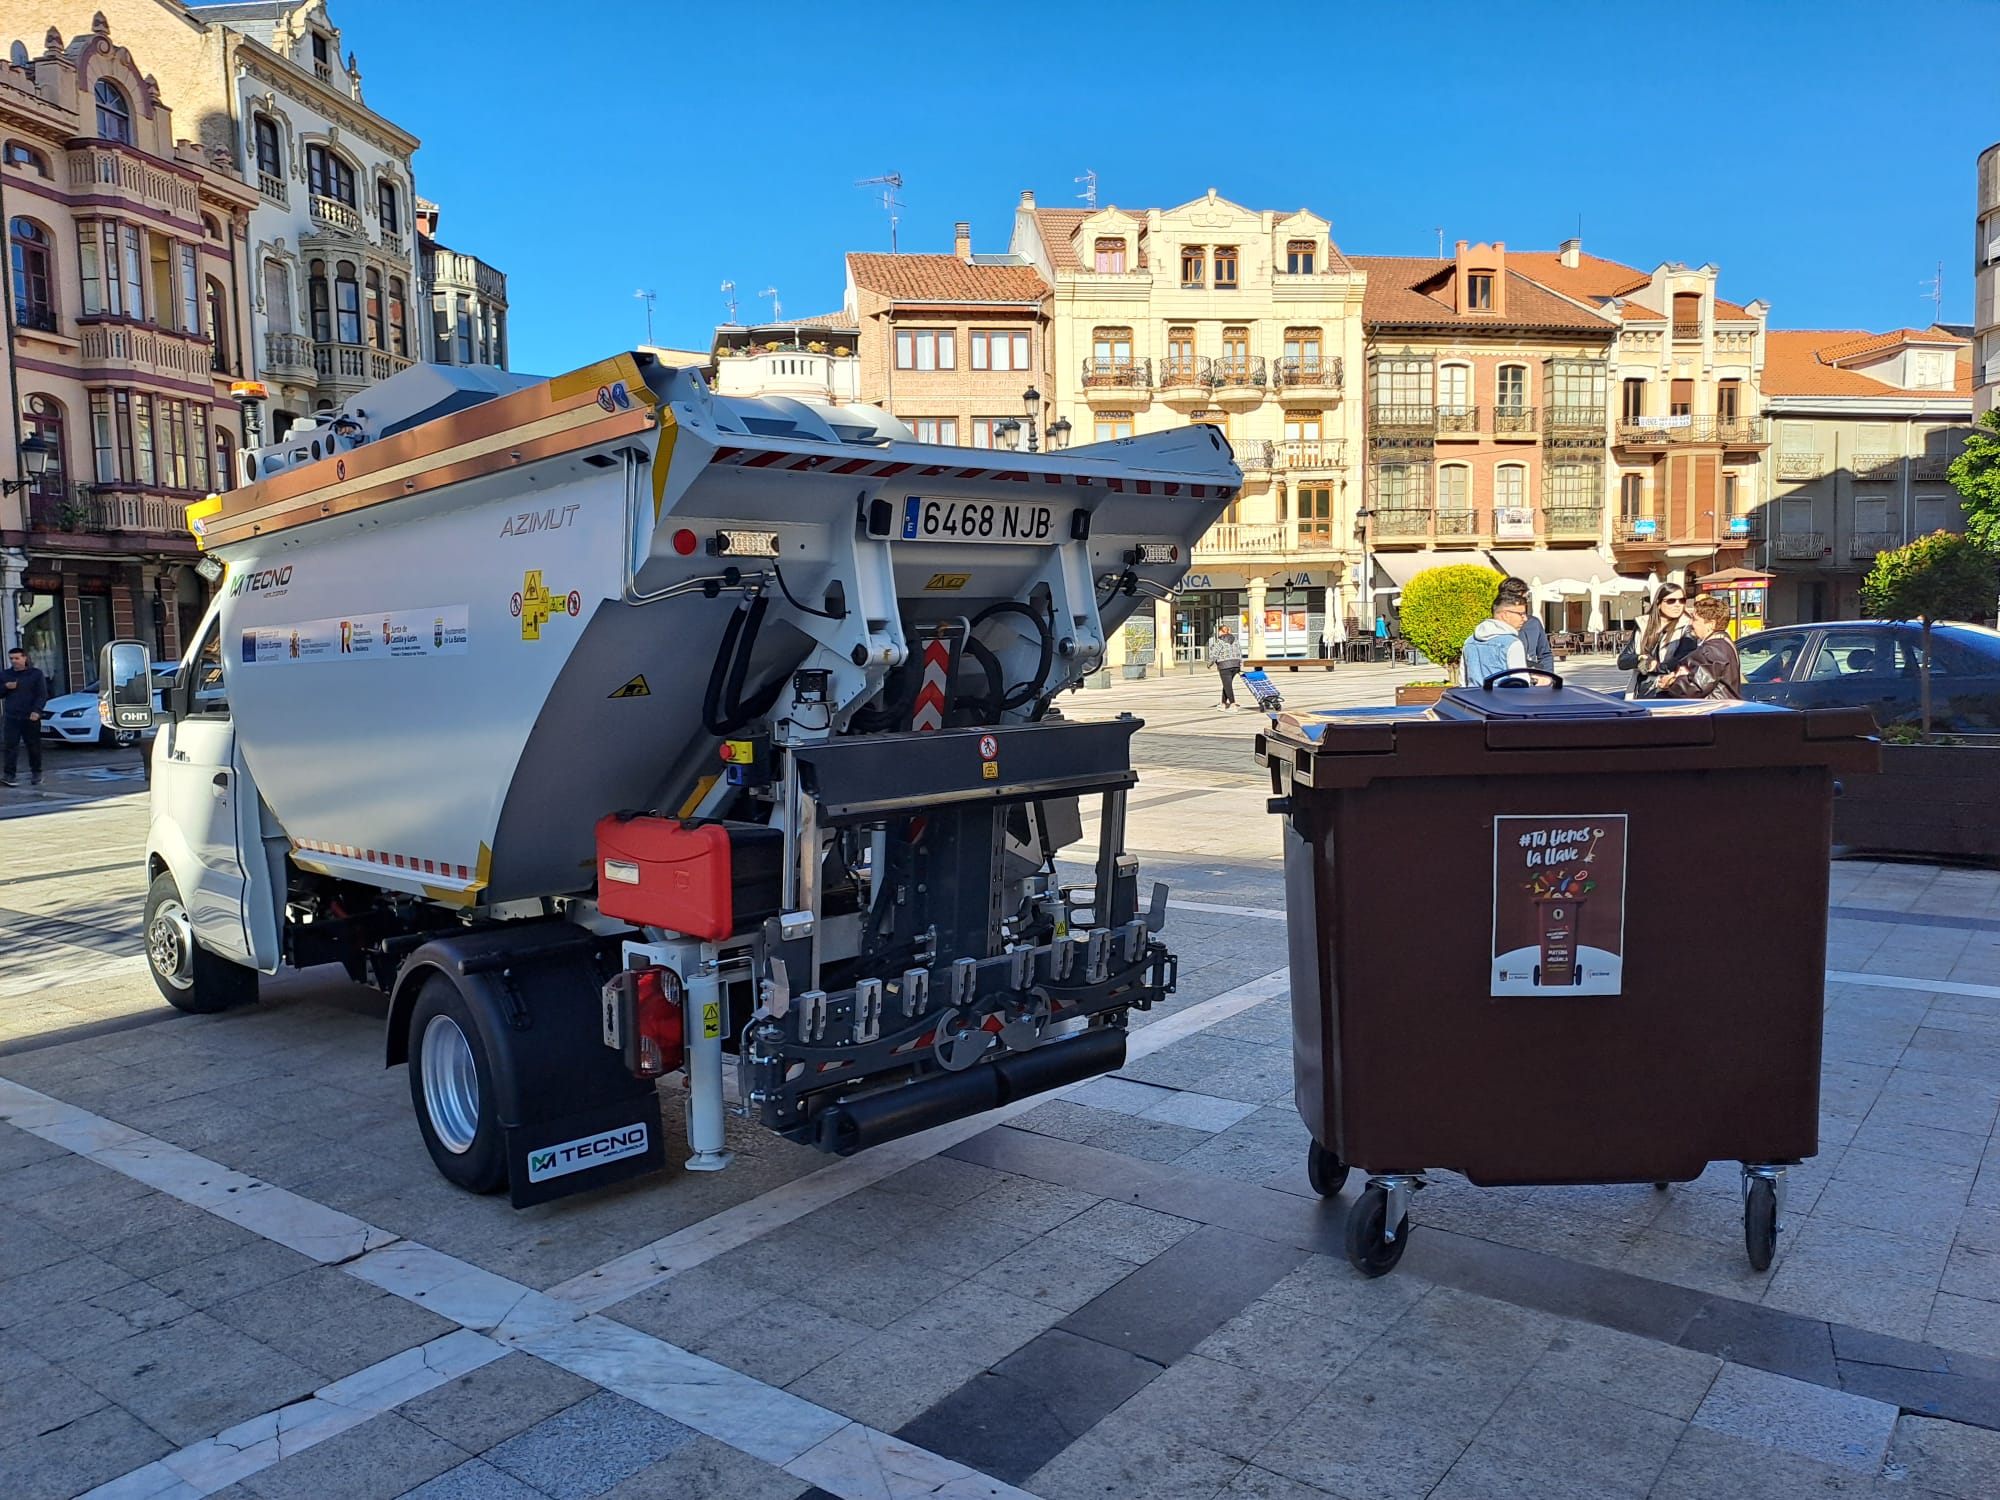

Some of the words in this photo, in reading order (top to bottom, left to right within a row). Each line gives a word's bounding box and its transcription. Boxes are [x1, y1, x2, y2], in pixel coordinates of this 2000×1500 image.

[499, 504, 580, 538] AZIMUT
[907, 522, 914, 532] E
[923, 501, 994, 536] 6468
[1002, 506, 1050, 538] NJB
[246, 565, 293, 592] TECNO
[1178, 575, 1212, 588] NCA
[1526, 850, 1541, 868] la
[1545, 847, 1579, 866] llave
[560, 1129, 644, 1162] TECNO
